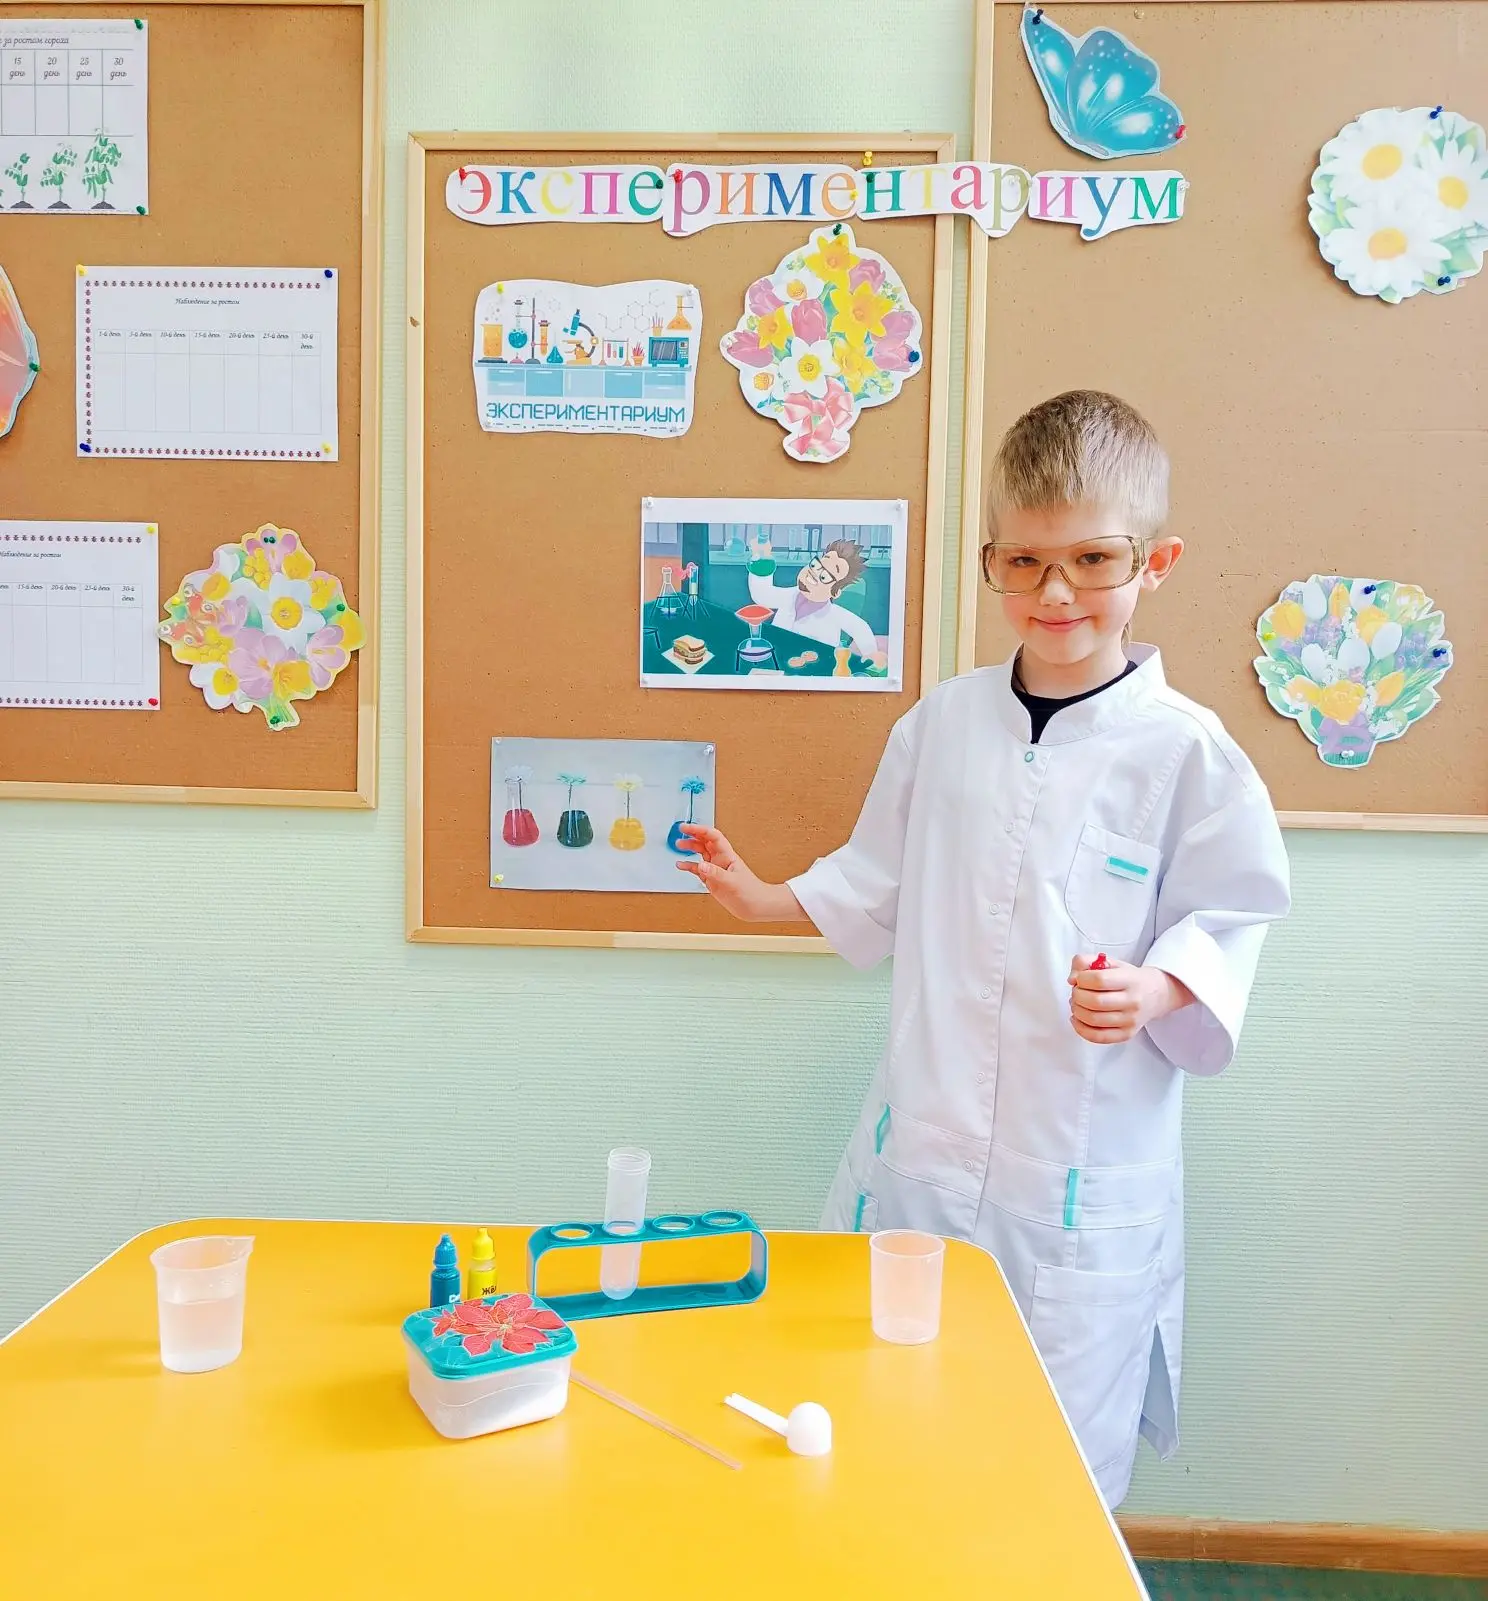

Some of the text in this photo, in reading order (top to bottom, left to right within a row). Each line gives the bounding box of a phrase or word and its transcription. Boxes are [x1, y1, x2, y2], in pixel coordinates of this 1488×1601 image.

[14, 57, 22, 65] 15
[47, 57, 57, 65] 20
[80, 57, 89, 65] 25
[113, 57, 124, 65] 30
[486, 402, 685, 423] ЭКСПЕРИМЕНТАРИУМ
